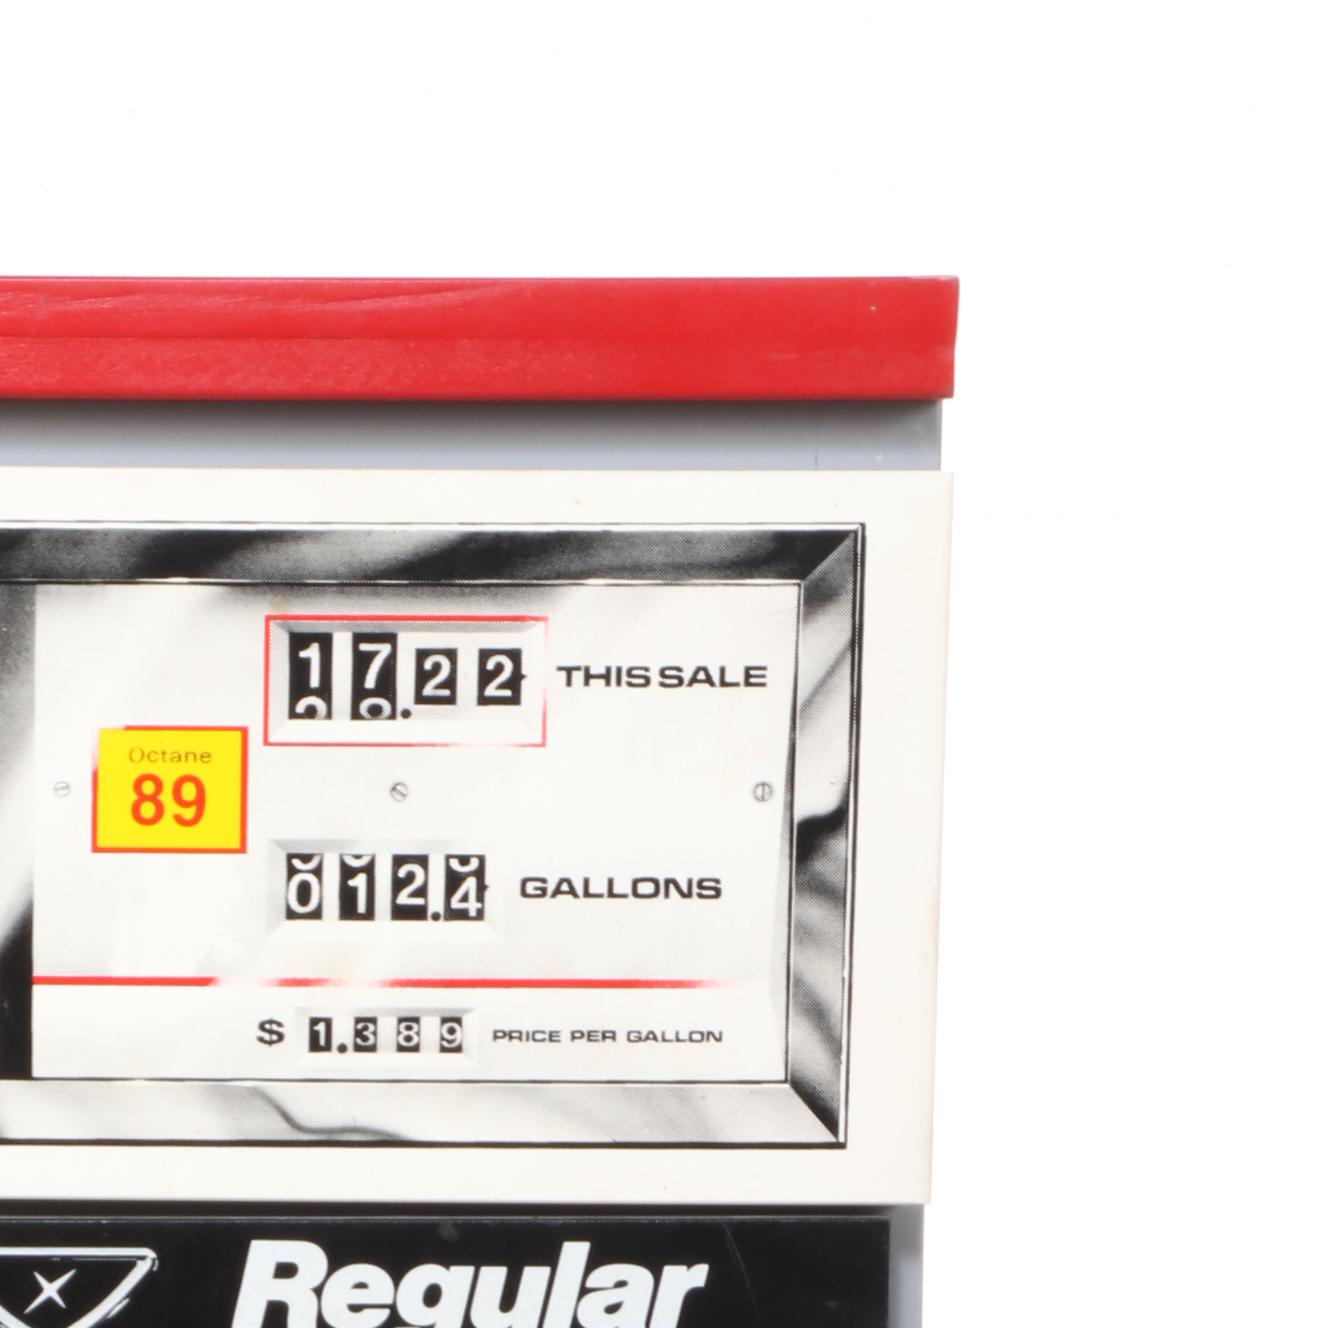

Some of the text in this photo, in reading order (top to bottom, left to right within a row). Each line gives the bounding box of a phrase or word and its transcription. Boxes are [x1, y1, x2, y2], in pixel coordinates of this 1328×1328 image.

[556, 665, 768, 688] THIS SALE
[128, 745, 213, 765] Octane
[129, 773, 206, 827] 89
[519, 875, 723, 900] GALLONS
[491, 1028, 562, 1043] PRICE
[570, 1028, 617, 1043] PER
[626, 1028, 724, 1044] GALLON
